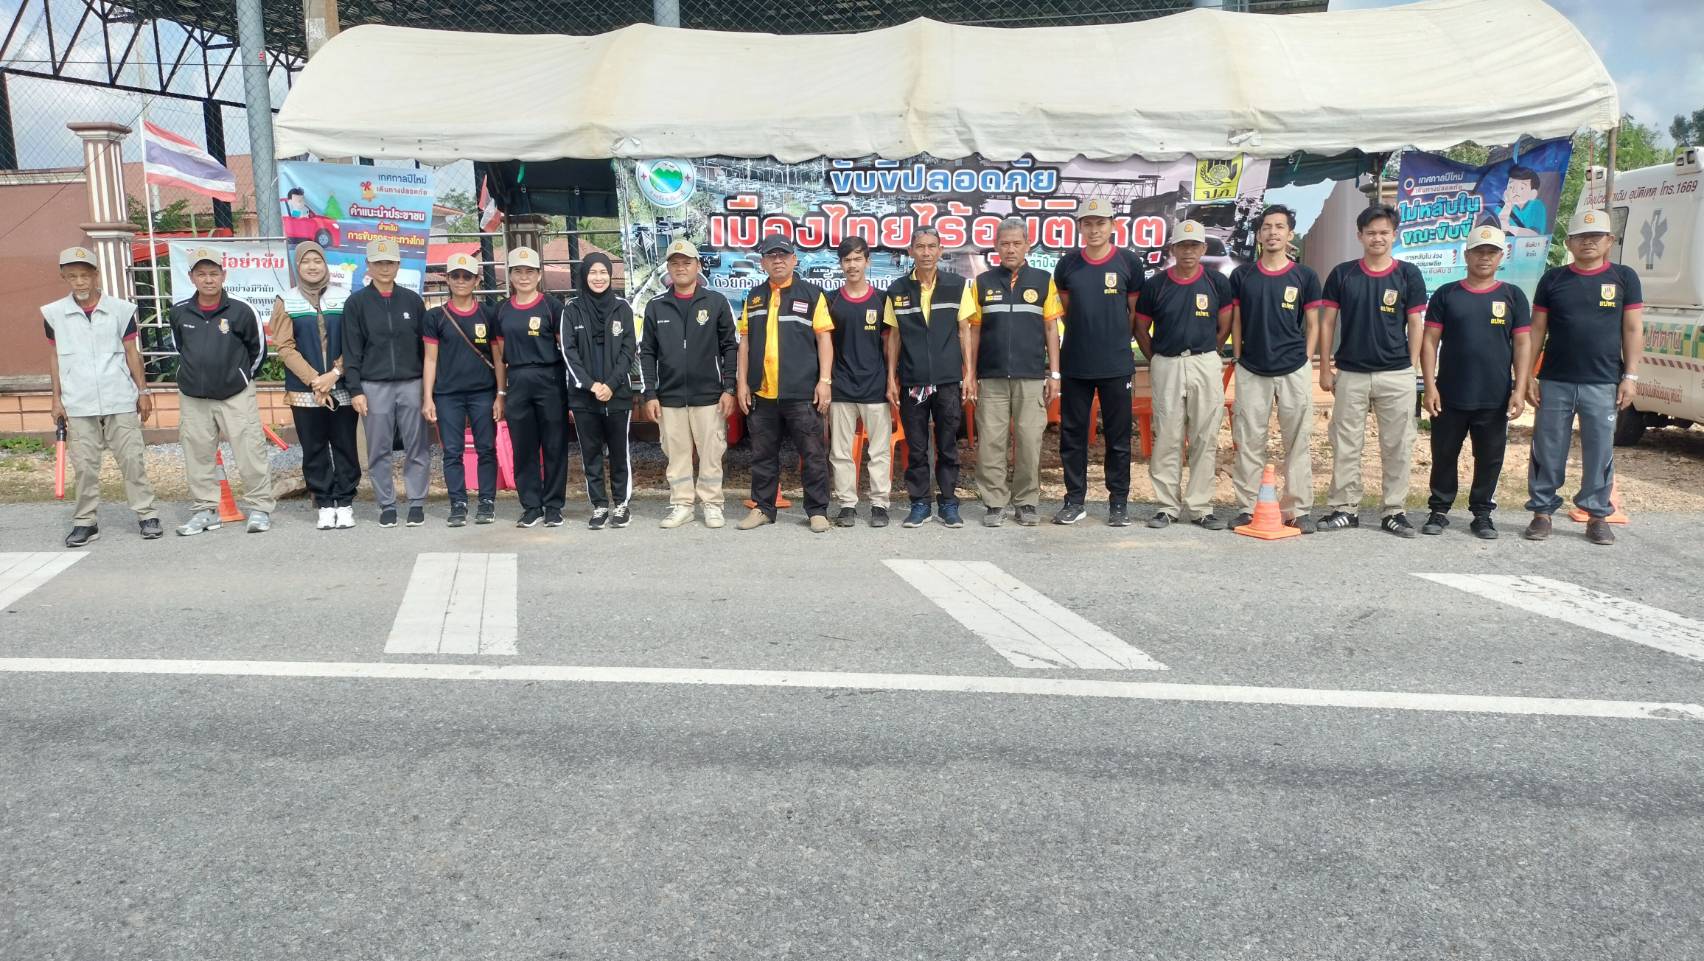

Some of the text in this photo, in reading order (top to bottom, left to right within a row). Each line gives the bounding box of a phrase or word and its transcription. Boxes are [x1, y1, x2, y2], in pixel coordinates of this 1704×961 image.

[378, 173, 427, 185] เทศกาลปีใหม่
[830, 158, 1057, 194] ขับขีปลอดภัย
[1660, 180, 1698, 196] โทร.1669
[350, 203, 426, 222] คำแนะนำประชาชน
[1399, 191, 1481, 223] ไม่หลับใน
[347, 231, 425, 246] การขับรถยะทางไกล
[711, 194, 1167, 266] เมืองไทยไร้อุัติหตุ
